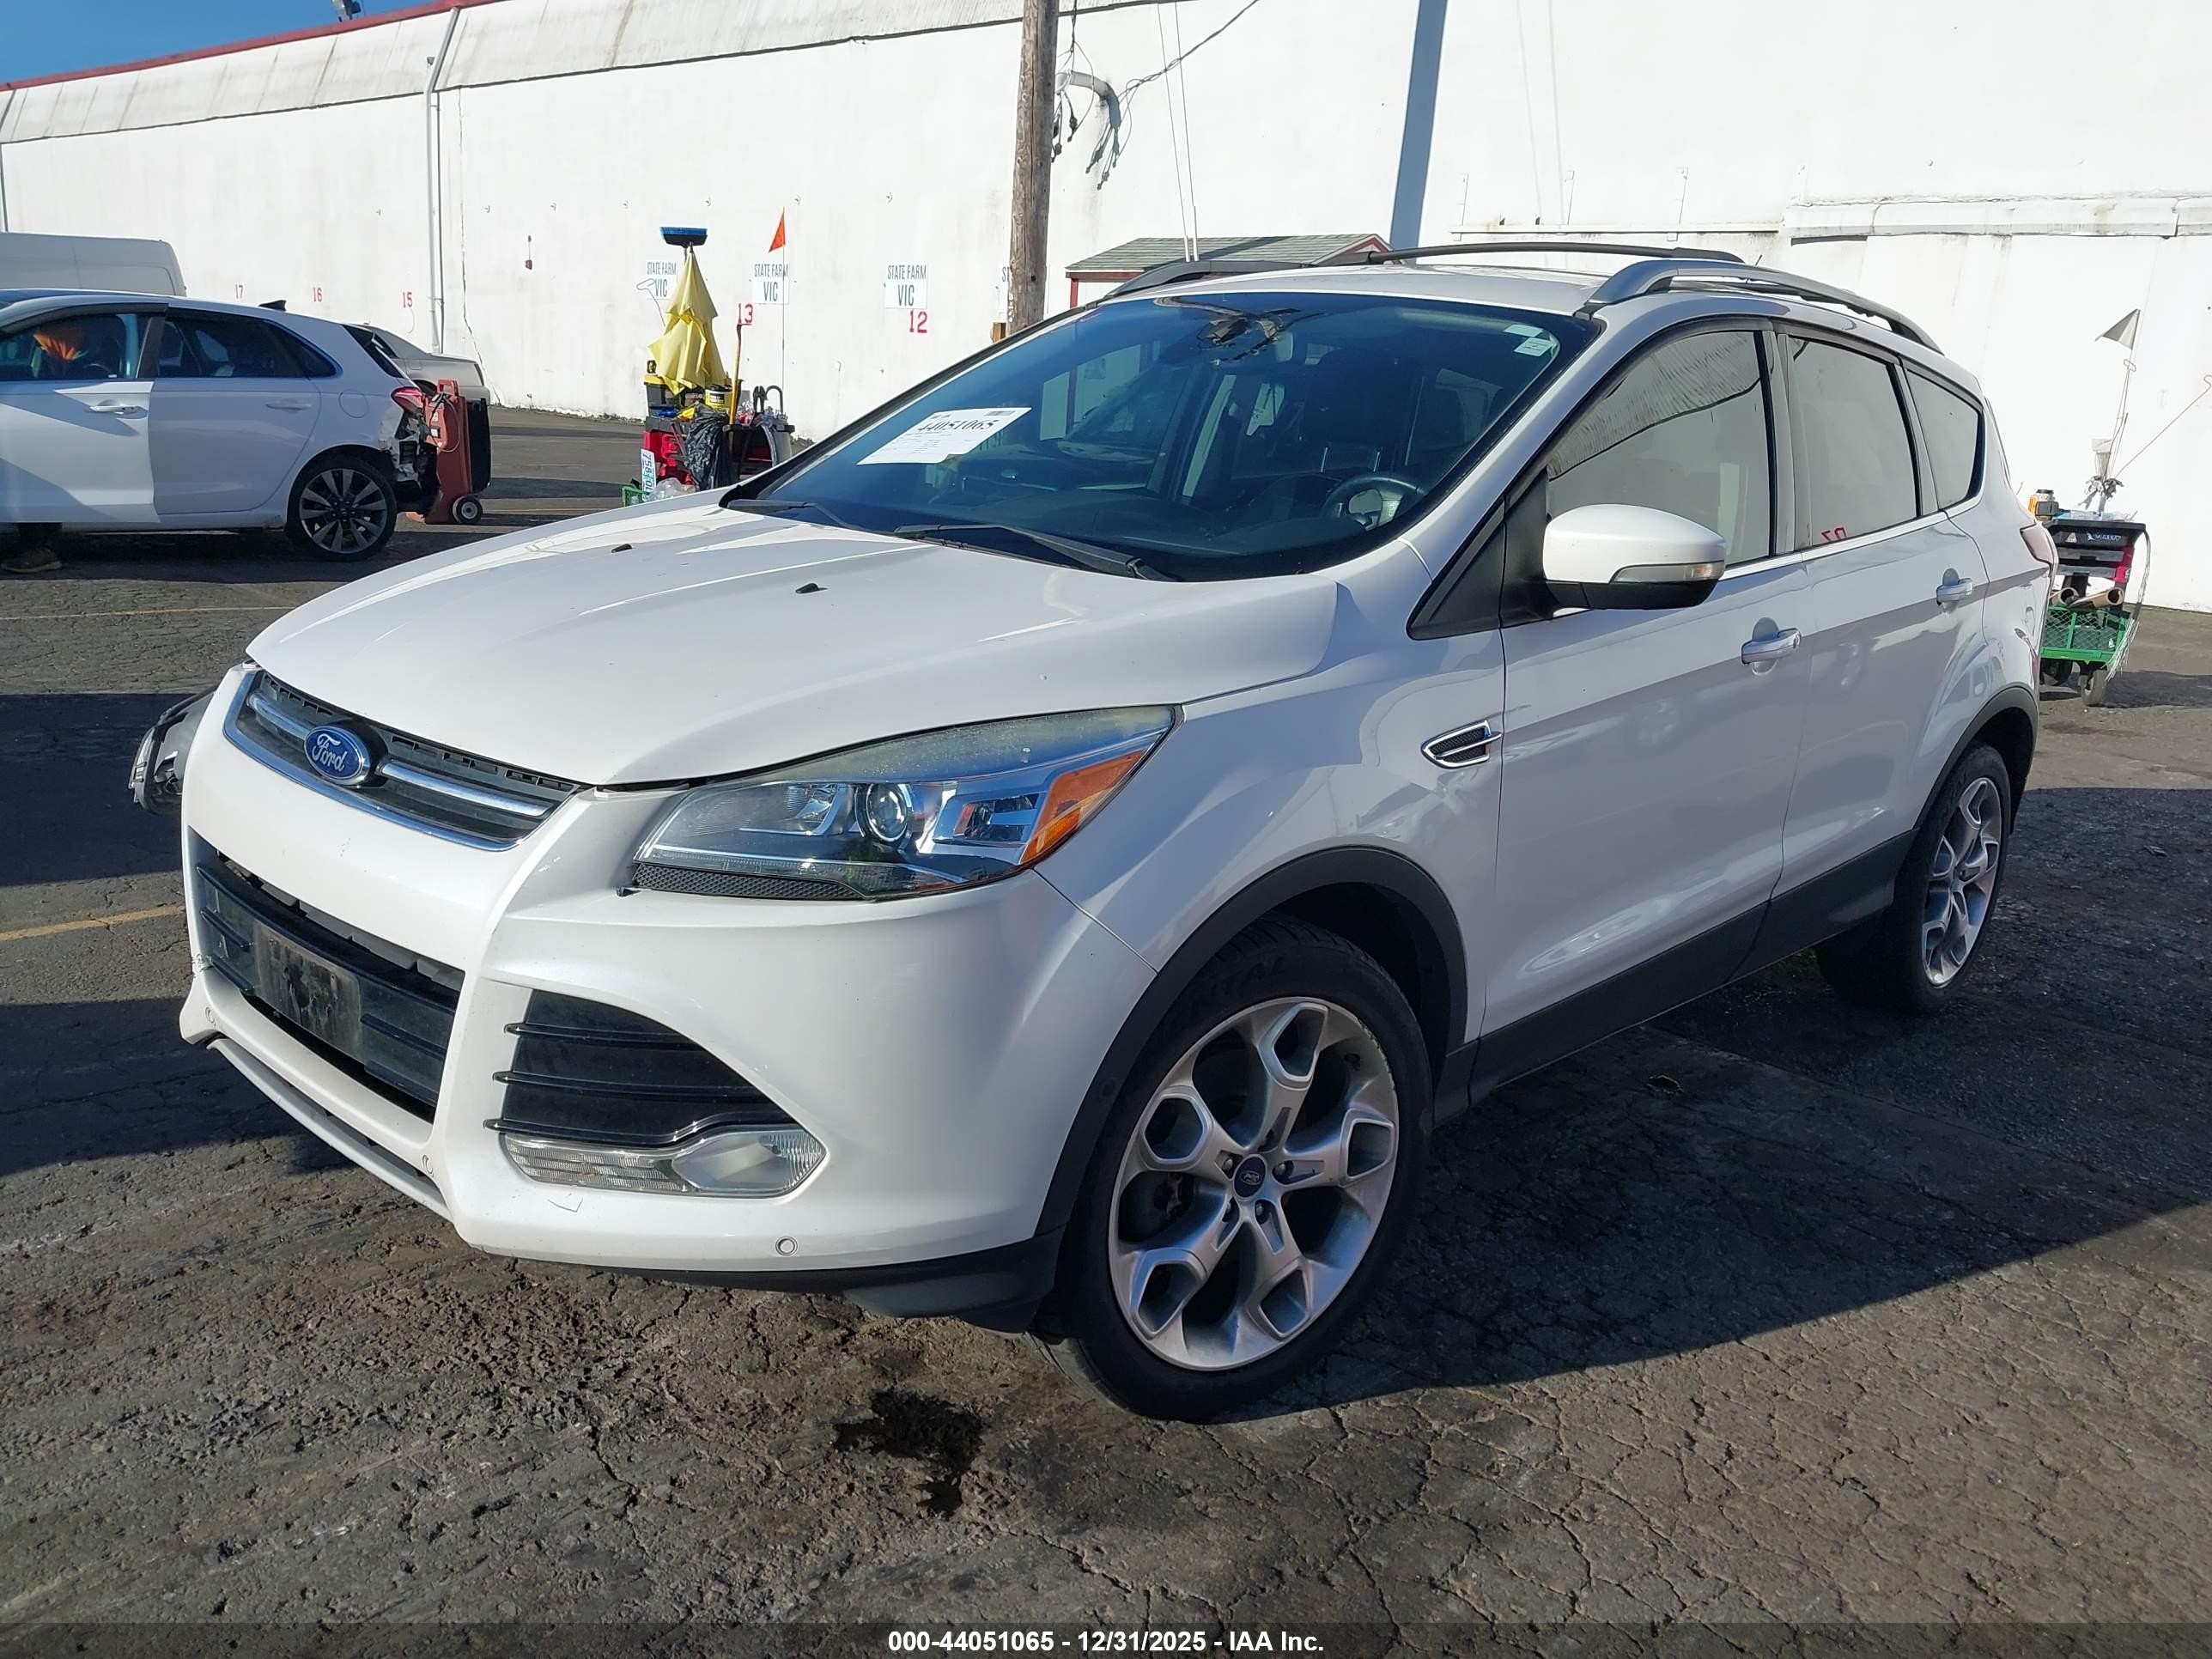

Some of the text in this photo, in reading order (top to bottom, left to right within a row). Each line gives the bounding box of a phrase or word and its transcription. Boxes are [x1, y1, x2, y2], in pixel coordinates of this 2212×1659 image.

[647, 261, 677, 276] STATE FARM
[754, 263, 789, 278] STATE FARM
[887, 264, 927, 280] STATE FARM
[234, 284, 244, 300] 17
[312, 287, 323, 302] 16
[654, 278, 668, 298] VIC
[763, 281, 779, 302] VIC
[897, 283, 915, 307] VIC
[402, 291, 413, 308] 15
[738, 302, 754, 325] 13
[909, 309, 927, 333] 12
[312, 732, 348, 772] Ford
